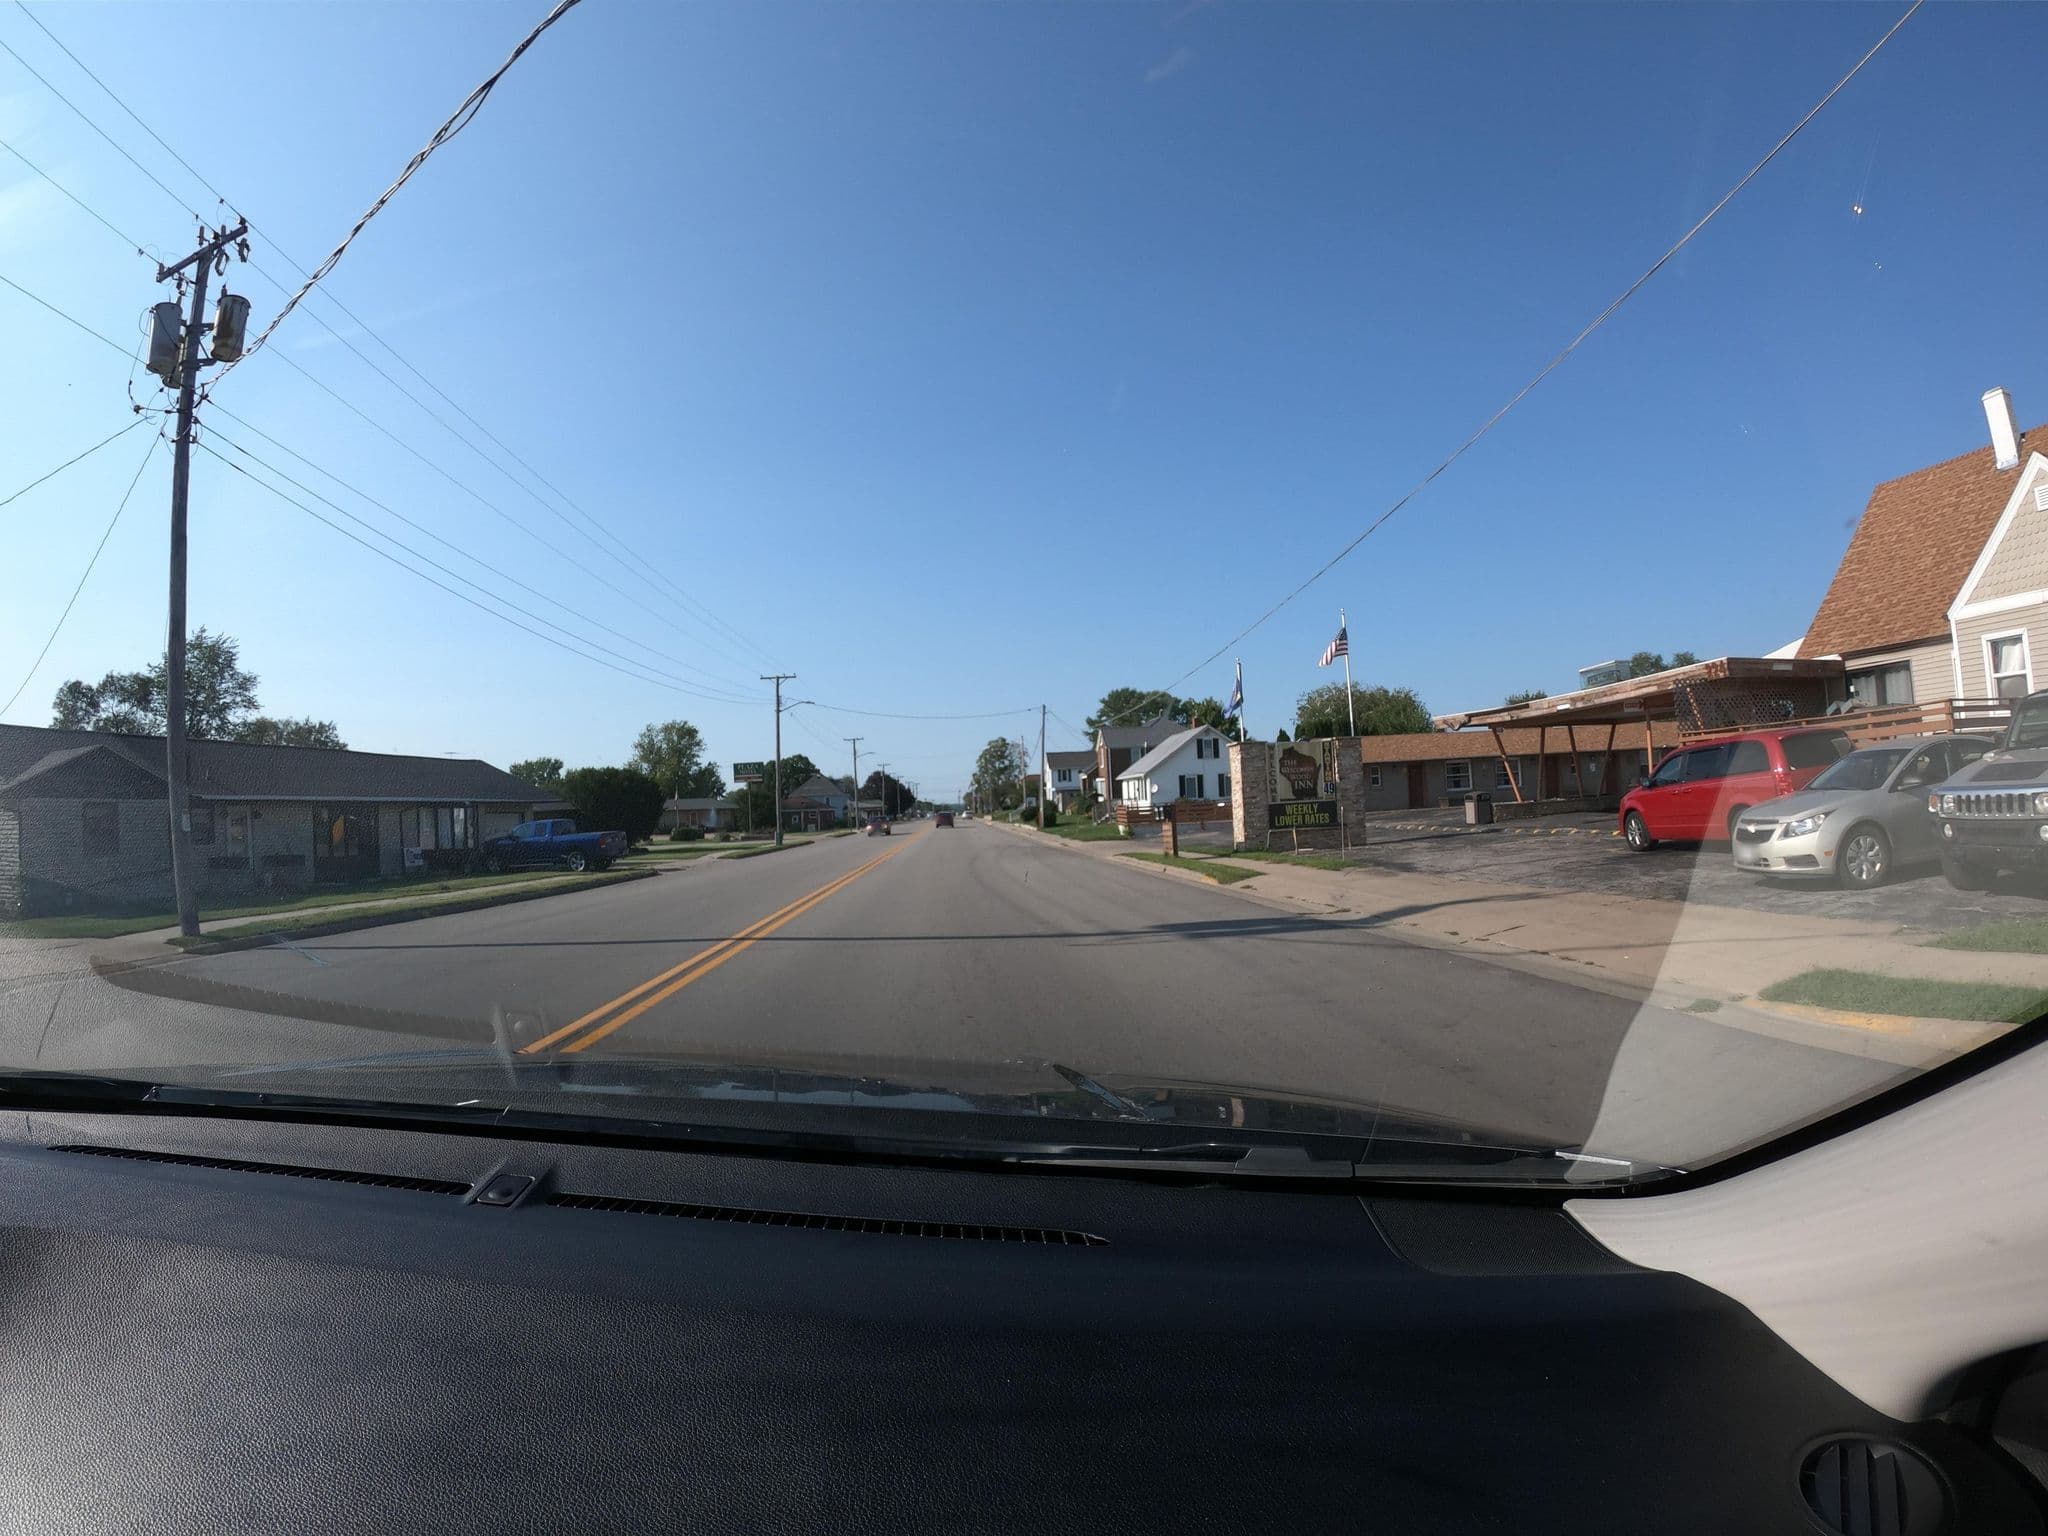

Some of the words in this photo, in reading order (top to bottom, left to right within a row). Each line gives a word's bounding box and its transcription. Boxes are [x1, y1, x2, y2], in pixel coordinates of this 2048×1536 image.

[1295, 780, 1313, 789] INN
[1324, 783, 1335, 794] 49
[1285, 803, 1319, 815] WEEKLY
[1275, 815, 1303, 826] LOWER
[1305, 813, 1330, 825] RATES
